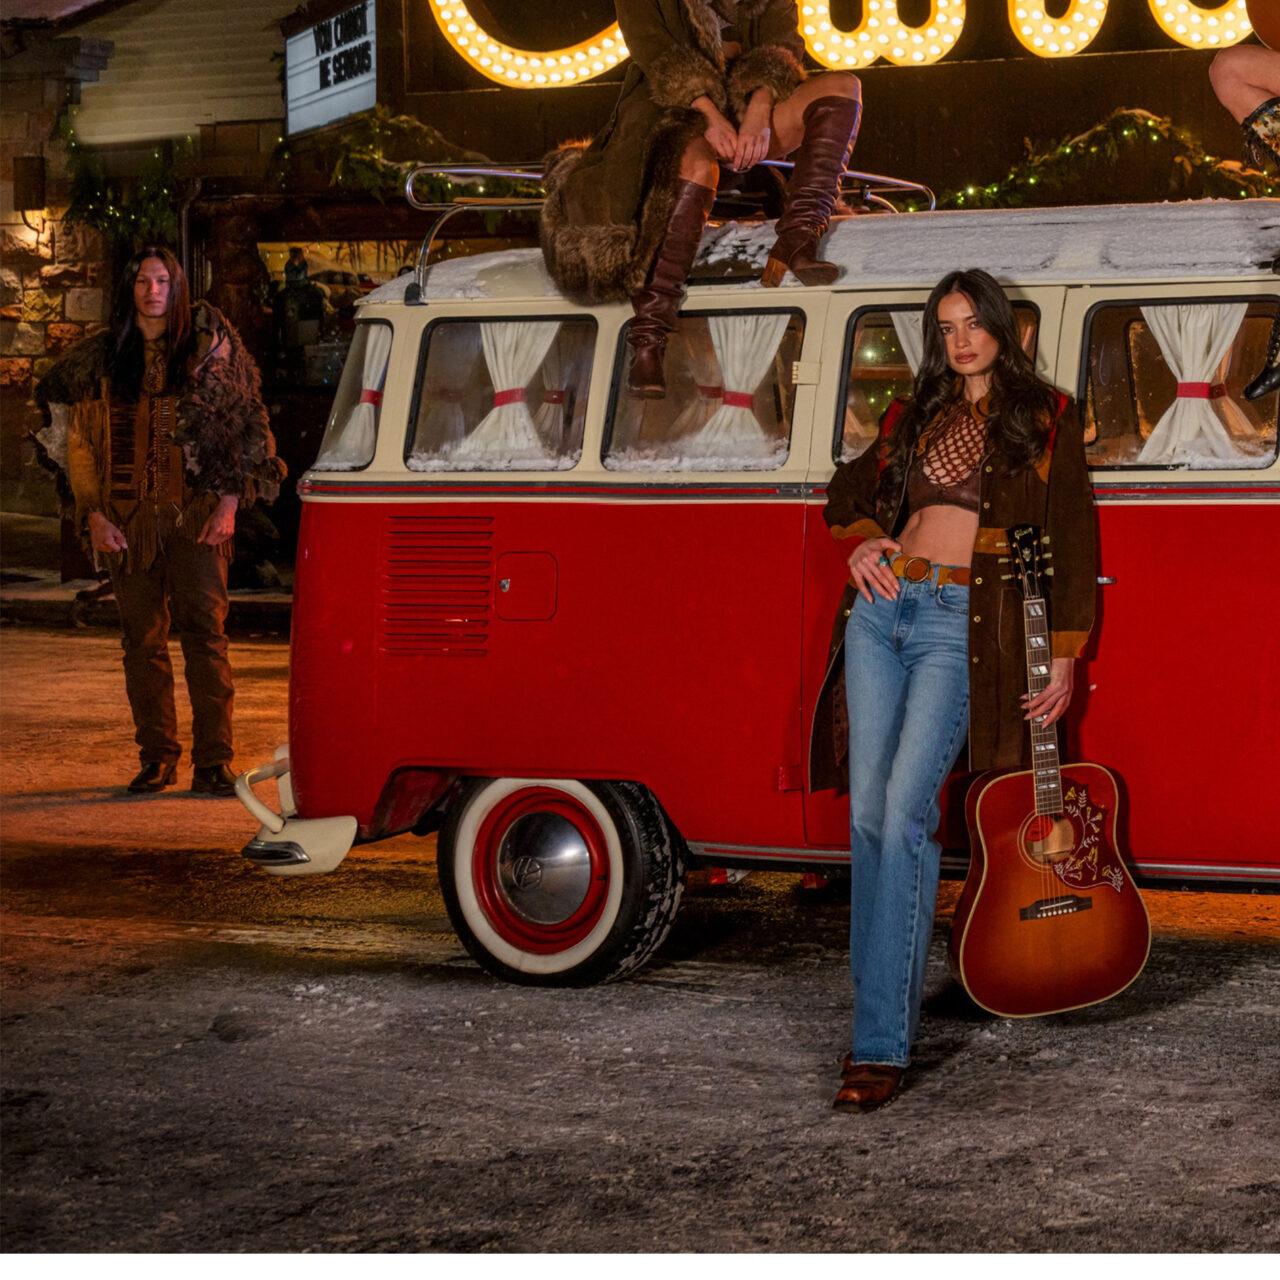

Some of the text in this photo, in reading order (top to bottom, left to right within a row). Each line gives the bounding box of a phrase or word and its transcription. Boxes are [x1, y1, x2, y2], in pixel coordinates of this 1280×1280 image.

[313, 21, 333, 56] YOU
[319, 40, 372, 90] BE SERIOUS
